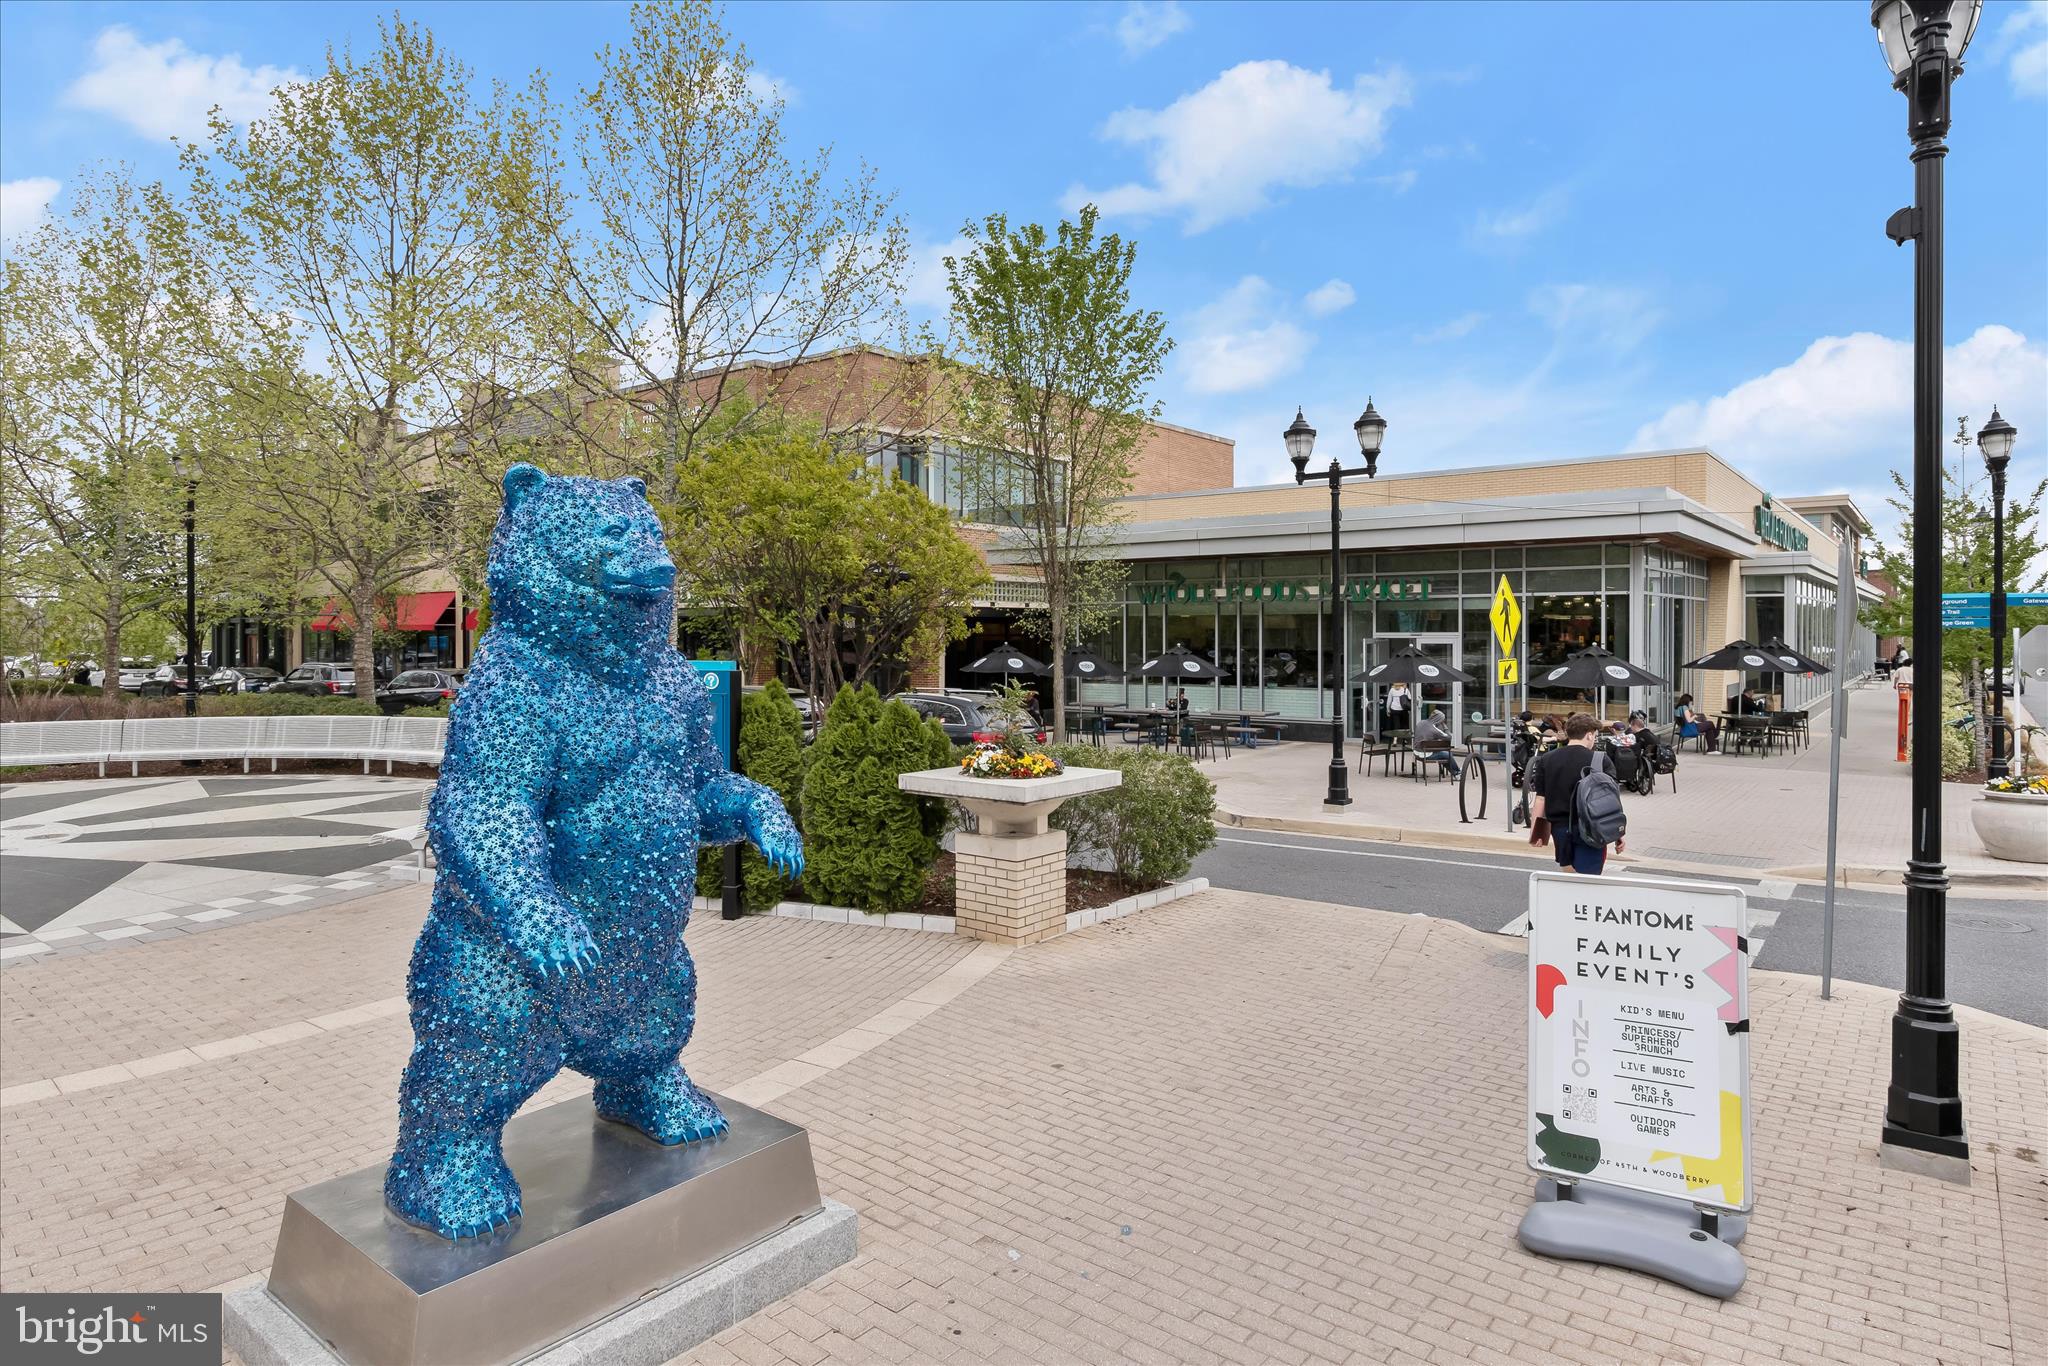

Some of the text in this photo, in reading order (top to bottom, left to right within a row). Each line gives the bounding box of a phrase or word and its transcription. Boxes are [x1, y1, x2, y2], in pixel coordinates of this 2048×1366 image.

[1136, 583, 1215, 605] WHOLE
[1225, 580, 1309, 602] FOODS
[1575, 904, 1693, 931] LE FANTOME
[1577, 938, 1681, 962] FAMILY
[1577, 962, 1694, 989] EVENT'S
[1620, 1005, 1685, 1021] KID'S MENU
[1571, 1000, 1590, 1077] INFO
[1621, 1033, 1679, 1048] SUPERHERO
[1624, 1025, 1681, 1040] PRINCESS/
[1620, 1061, 1686, 1078] LIVE MUSIC
[1631, 1084, 1670, 1098] ARTS &
[1634, 1093, 1673, 1107] CRAFTS
[1630, 1114, 1676, 1129] OUTDOOR
[1636, 1124, 1670, 1137] GAMES
[1561, 1151, 1595, 1162] CORNER
[1616, 1162, 1637, 1170] 45TH
[1652, 1169, 1710, 1184] WOODBERRY
